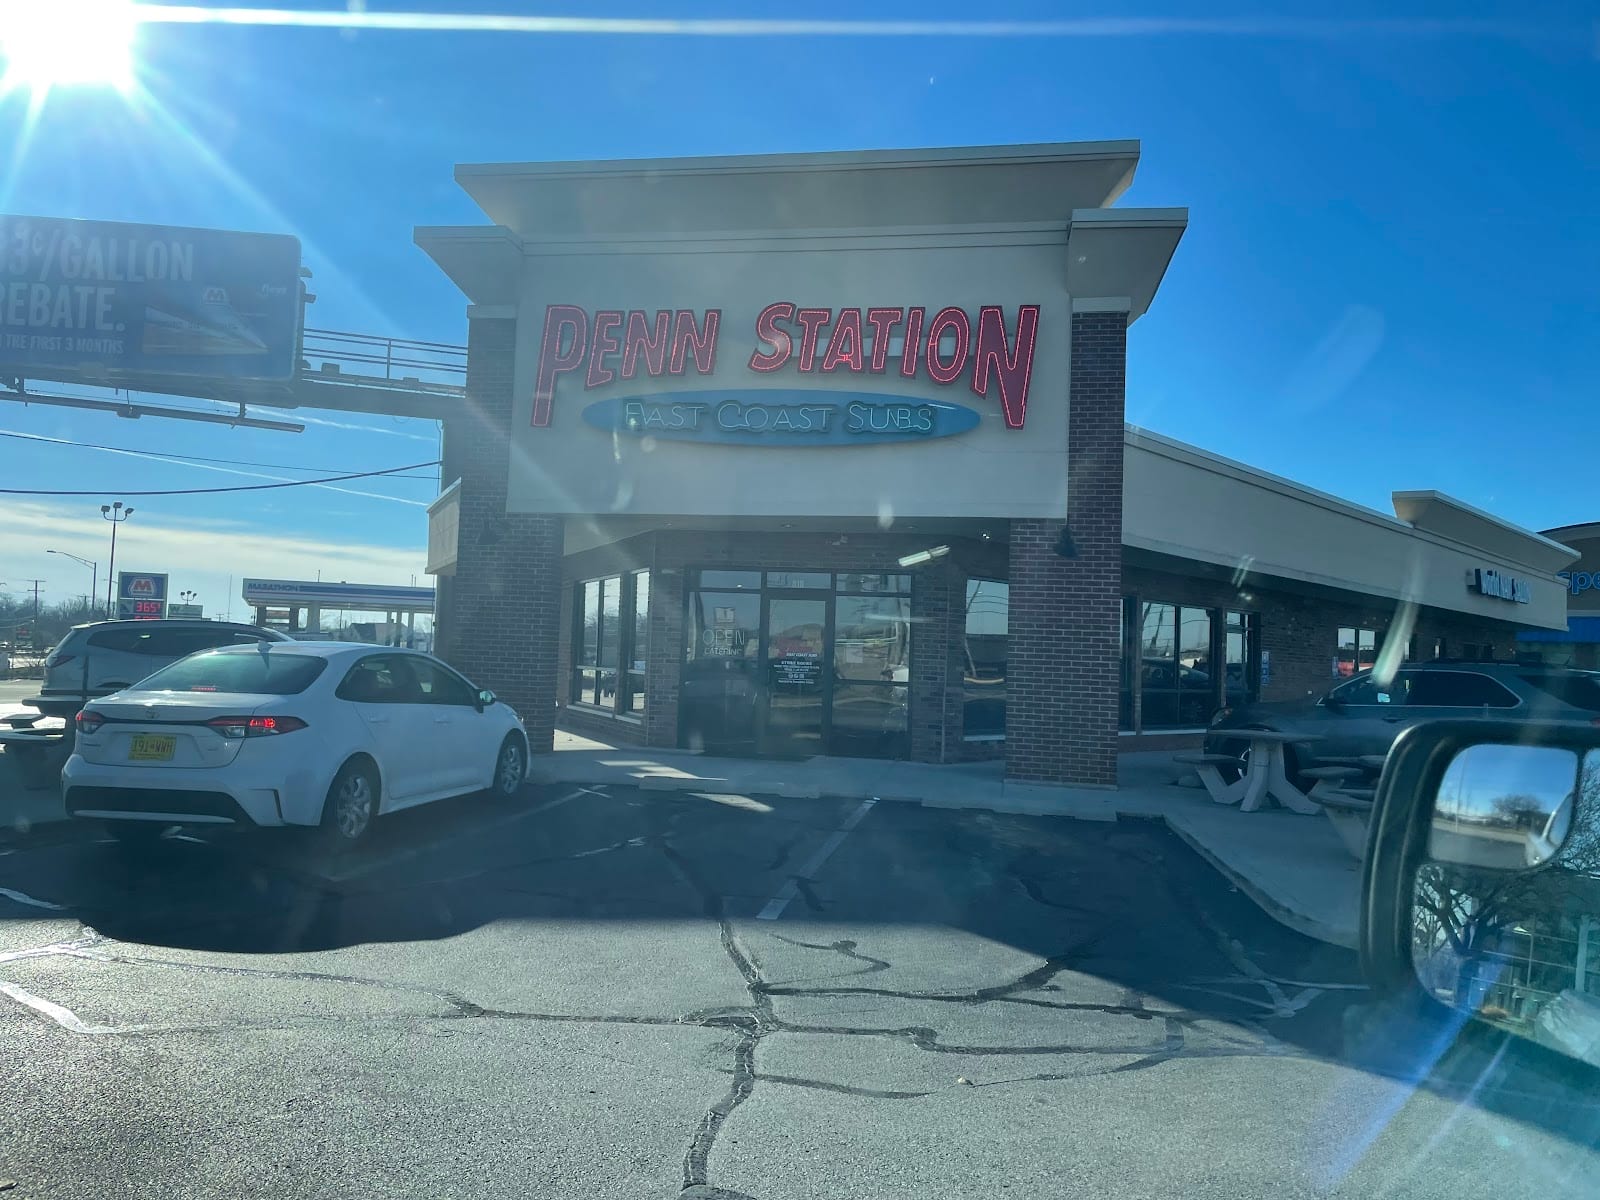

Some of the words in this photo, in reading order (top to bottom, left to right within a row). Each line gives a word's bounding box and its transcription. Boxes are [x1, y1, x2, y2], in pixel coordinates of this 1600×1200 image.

[6, 334, 31, 350] THE
[31, 335, 63, 351] FIRST
[65, 337, 74, 351] 3
[76, 338, 125, 354] MONTHS
[530, 304, 722, 427] PENN
[748, 302, 1040, 430] STATION
[625, 402, 705, 427] EAST
[717, 403, 834, 429] COAST
[847, 403, 933, 430] SUBS
[702, 629, 745, 646] OPEN
